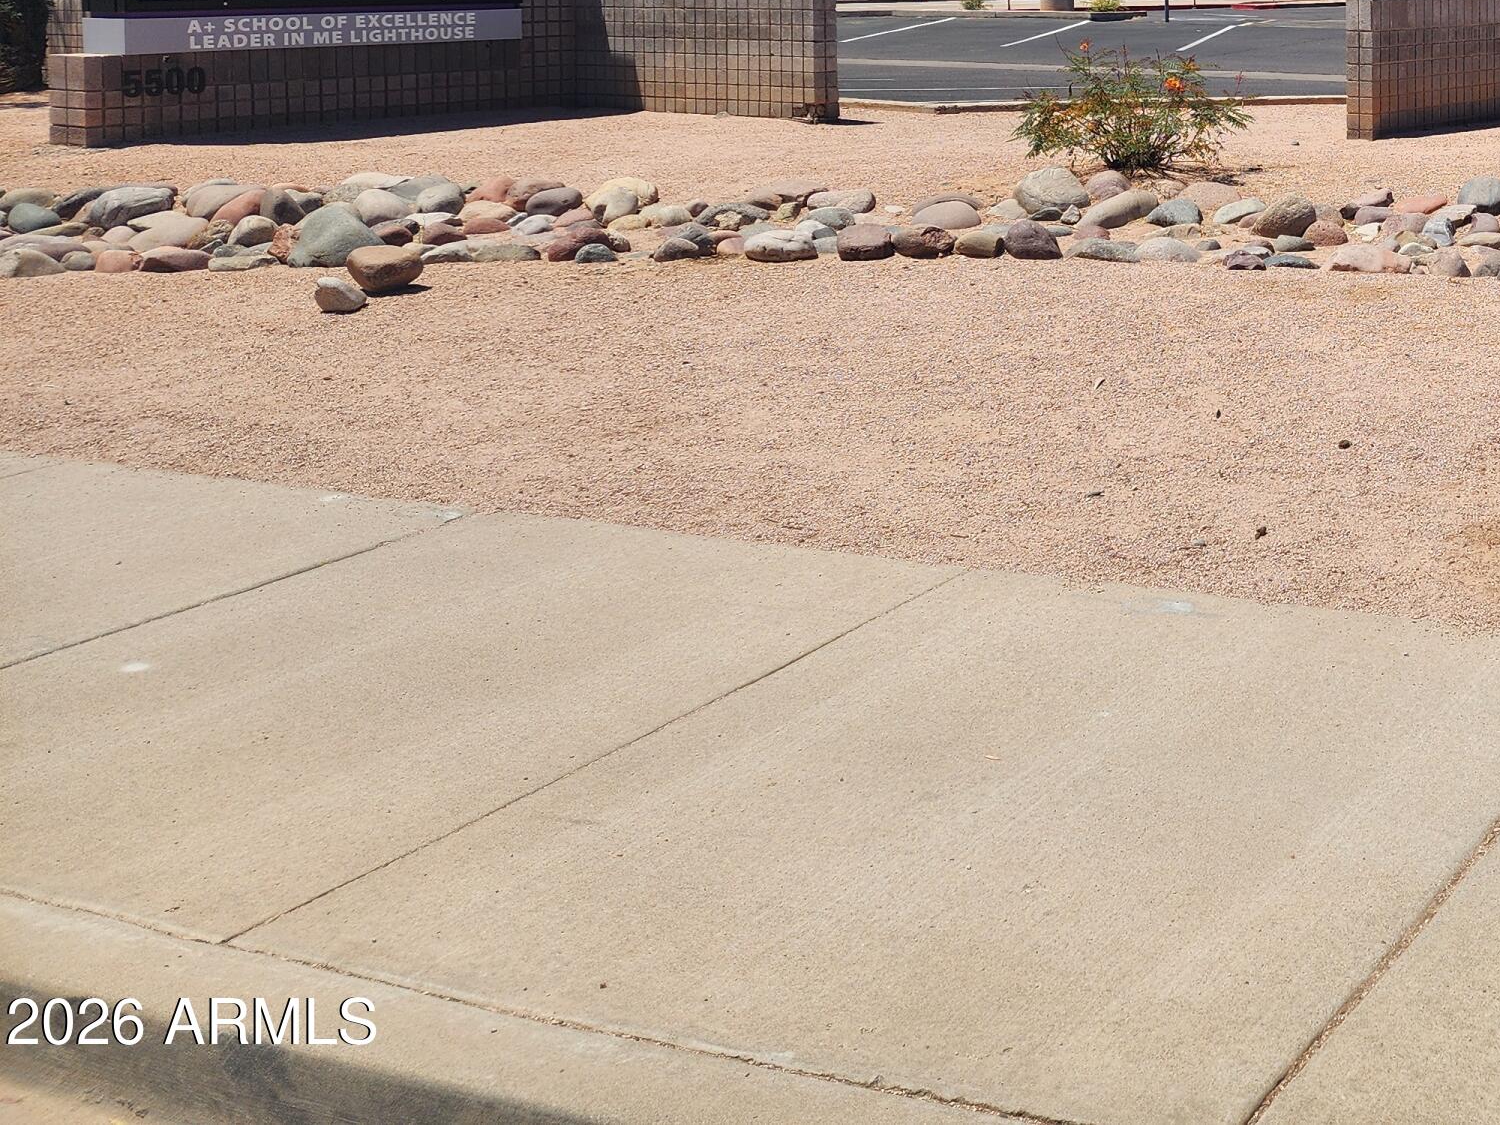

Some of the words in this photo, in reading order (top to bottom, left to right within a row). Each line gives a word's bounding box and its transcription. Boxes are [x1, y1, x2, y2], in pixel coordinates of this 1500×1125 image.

[187, 19, 216, 35] A+
[224, 16, 313, 32] SCHOOL
[320, 15, 348, 29] OF
[355, 12, 477, 28] EXCELLENCE
[189, 32, 275, 50] LEADER
[284, 31, 305, 46] IN
[313, 30, 343, 45] ME
[351, 26, 475, 44] LIGHTHOUSE
[122, 65, 206, 98] 5500
